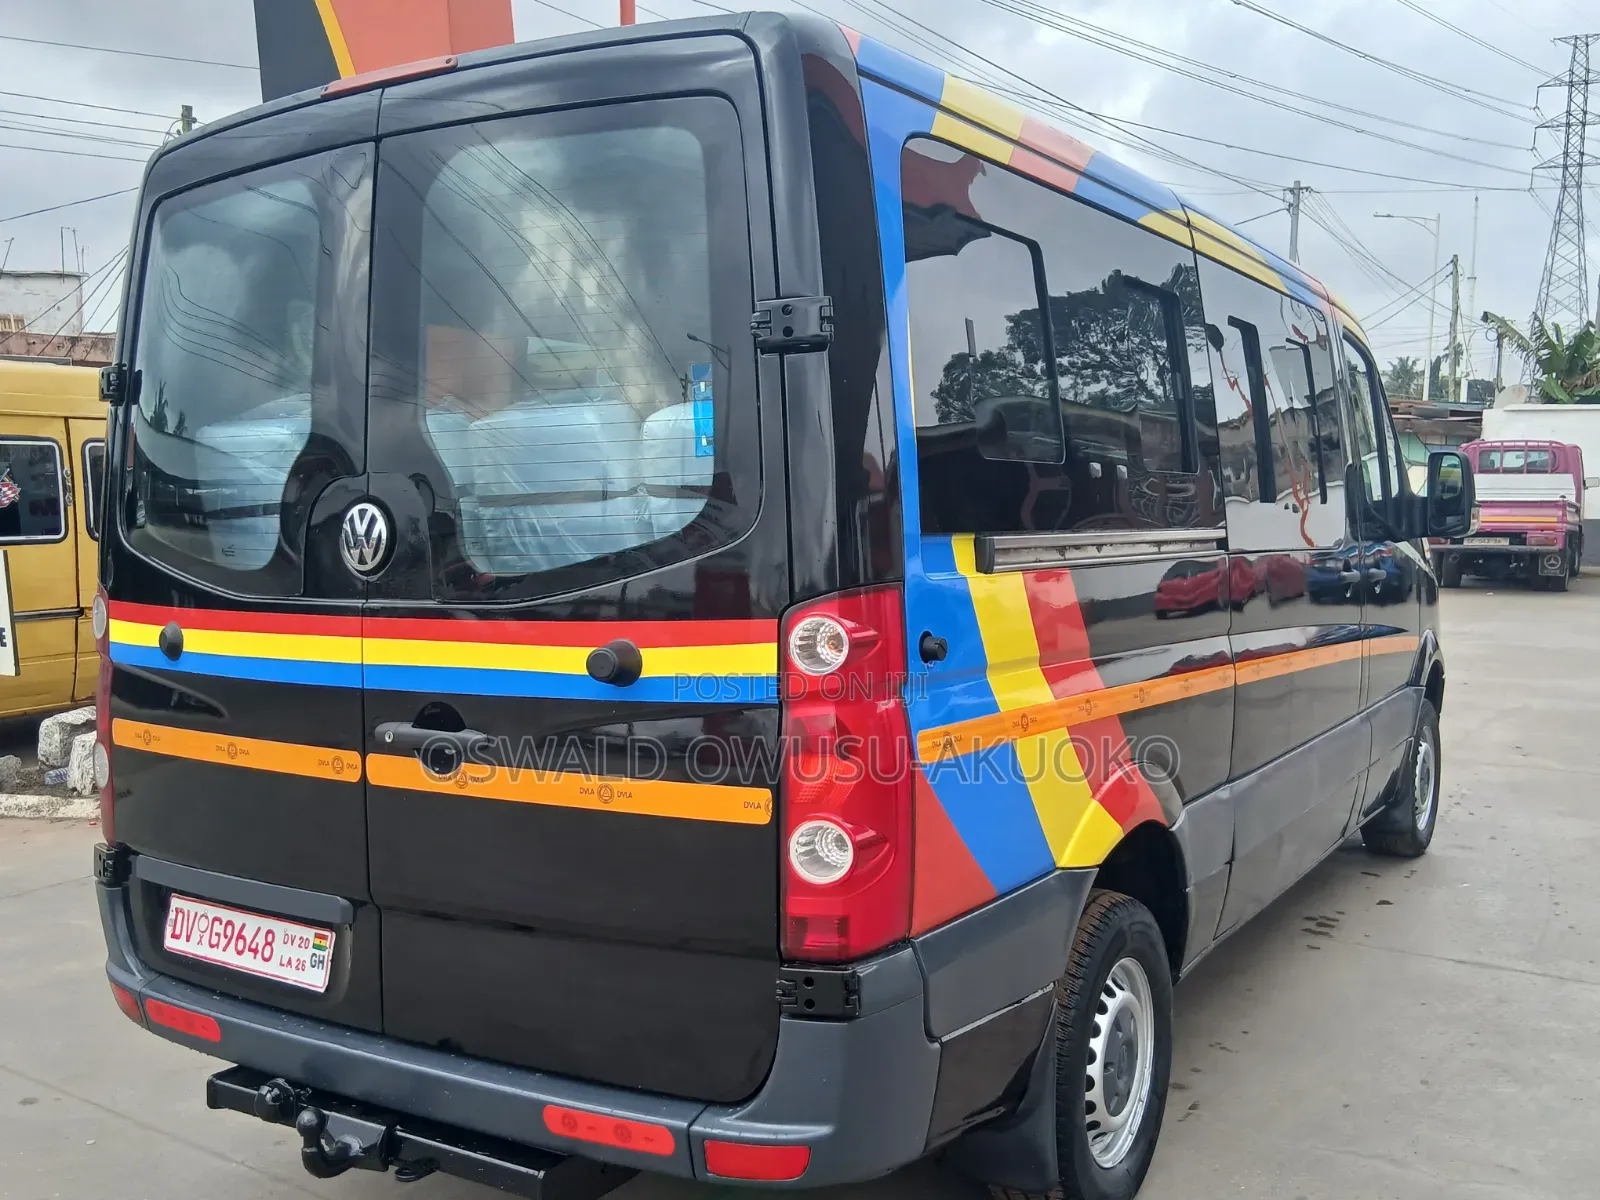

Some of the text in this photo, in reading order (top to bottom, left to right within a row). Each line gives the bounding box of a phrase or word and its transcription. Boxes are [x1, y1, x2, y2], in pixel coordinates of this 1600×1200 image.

[579, 786, 595, 796] DVLA
[616, 790, 633, 799] DVLA
[743, 800, 762, 810] DVLA
[170, 906, 198, 942] DV
[208, 915, 276, 963] G9648
[282, 933, 310, 950] DV 20
[279, 954, 307, 972] LA 26
[310, 952, 326, 971] GH
